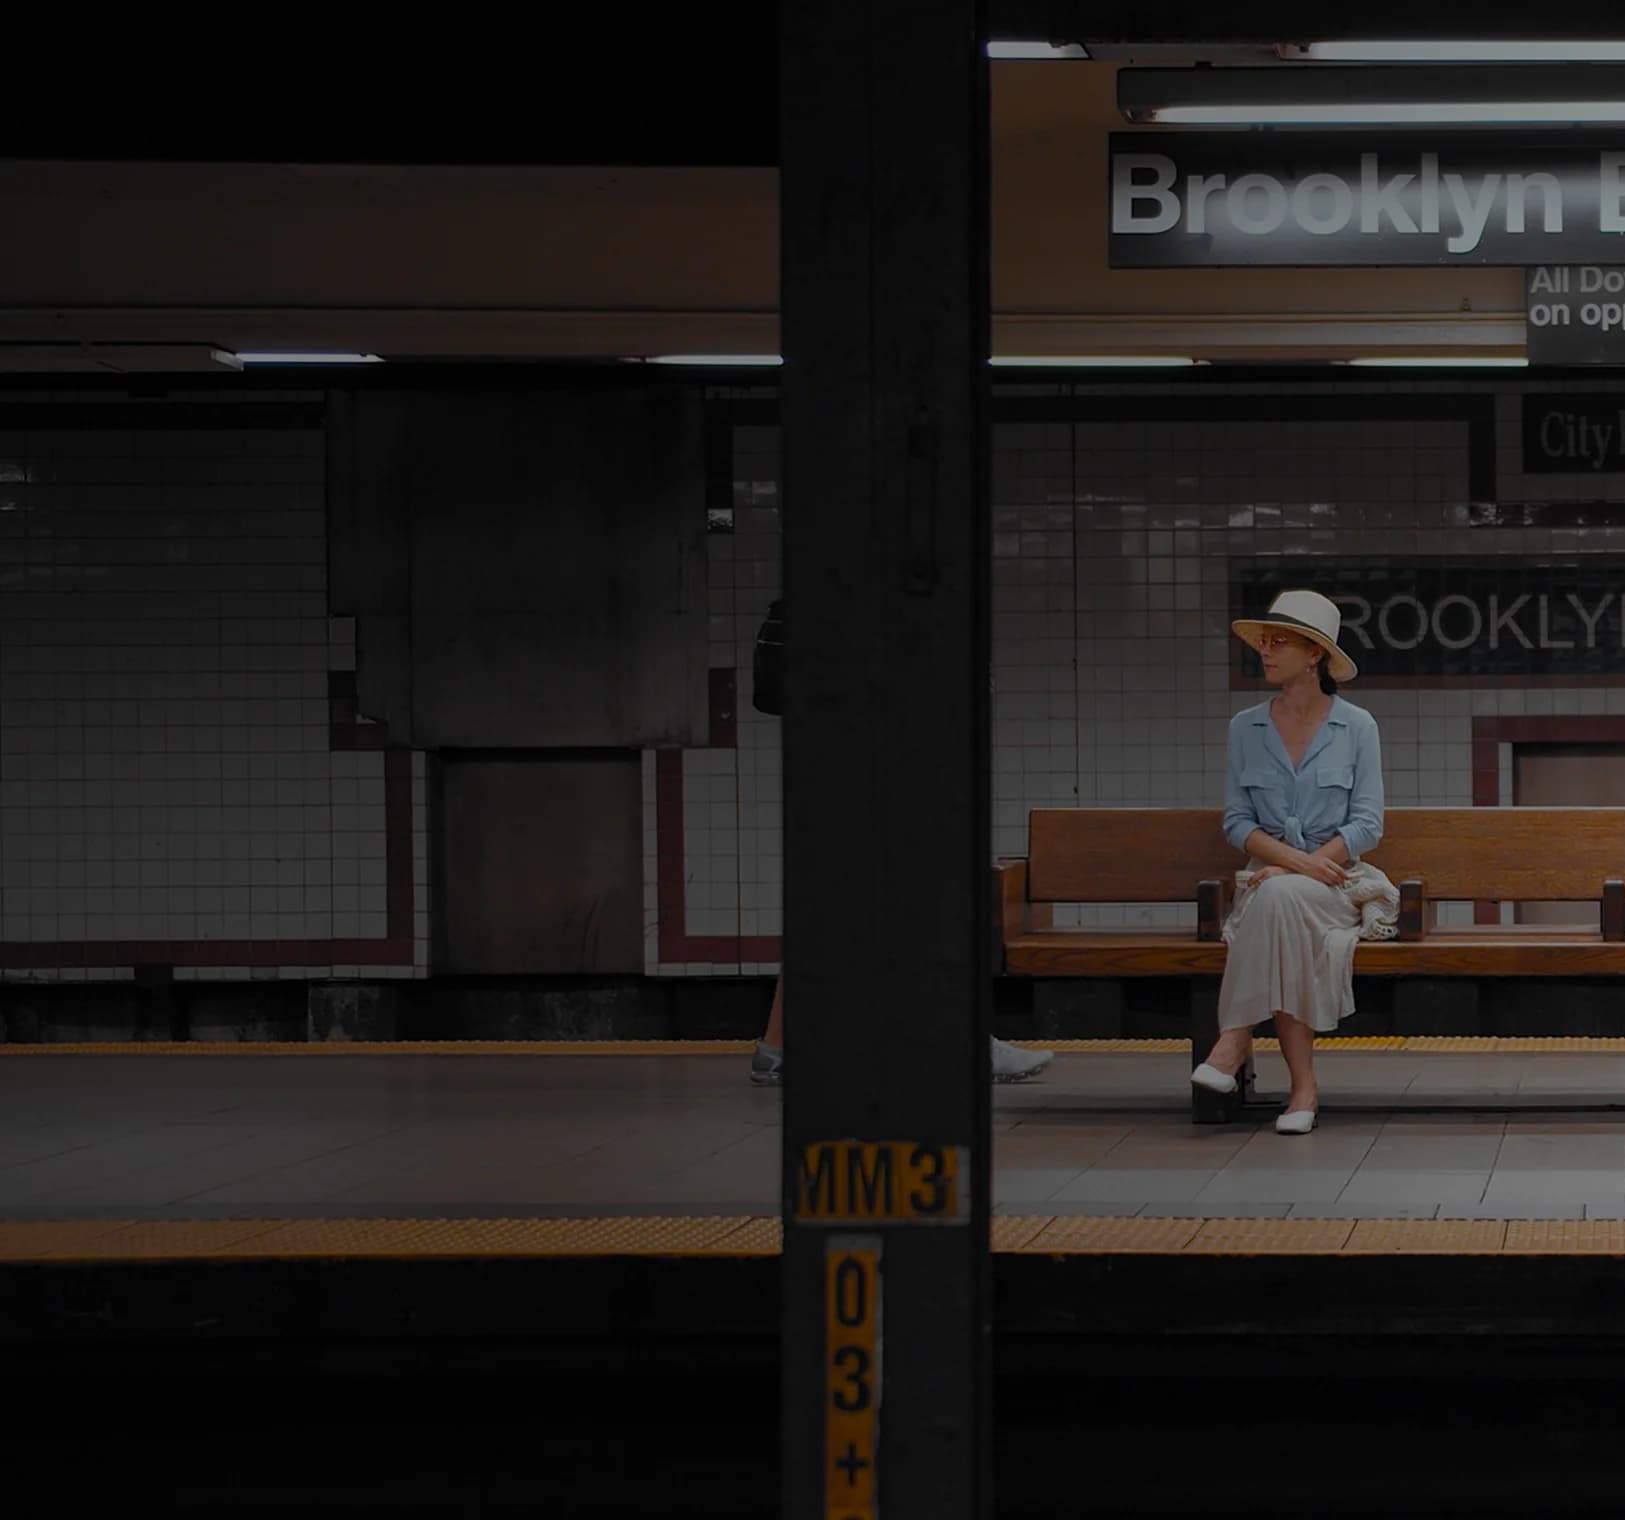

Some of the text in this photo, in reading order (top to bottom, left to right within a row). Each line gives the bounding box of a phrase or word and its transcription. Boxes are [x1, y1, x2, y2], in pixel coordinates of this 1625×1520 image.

[1111, 152, 1564, 253] Brooklyn
[1530, 266, 1569, 294] All
[1529, 302, 1571, 327] on
[1540, 410, 1614, 469] City
